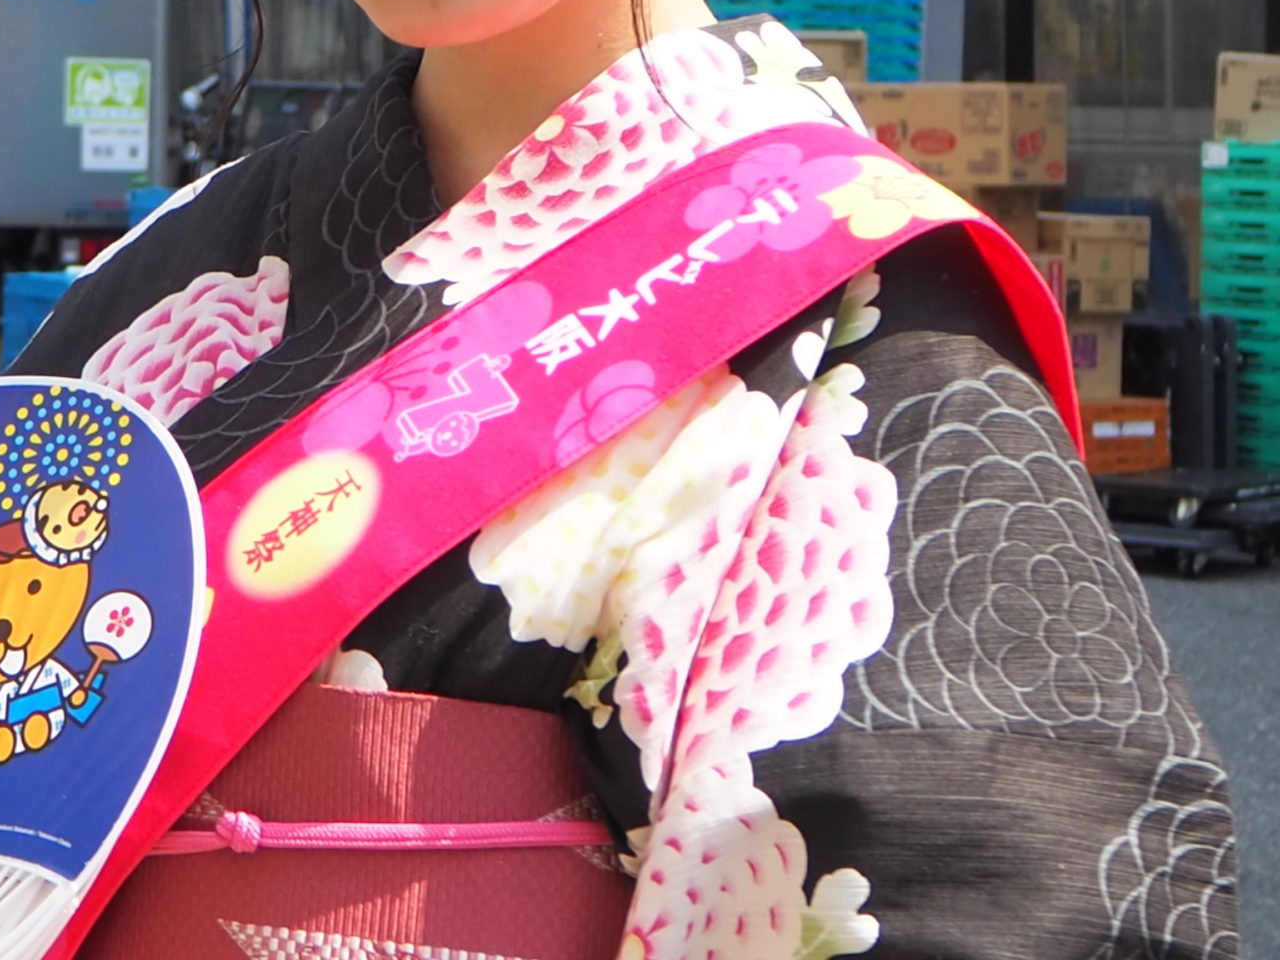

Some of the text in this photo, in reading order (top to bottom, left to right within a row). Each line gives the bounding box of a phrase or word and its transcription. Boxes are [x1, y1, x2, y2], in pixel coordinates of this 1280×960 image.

[525, 187, 799, 376] テレビ大阪
[242, 469, 362, 573] 天神祭
